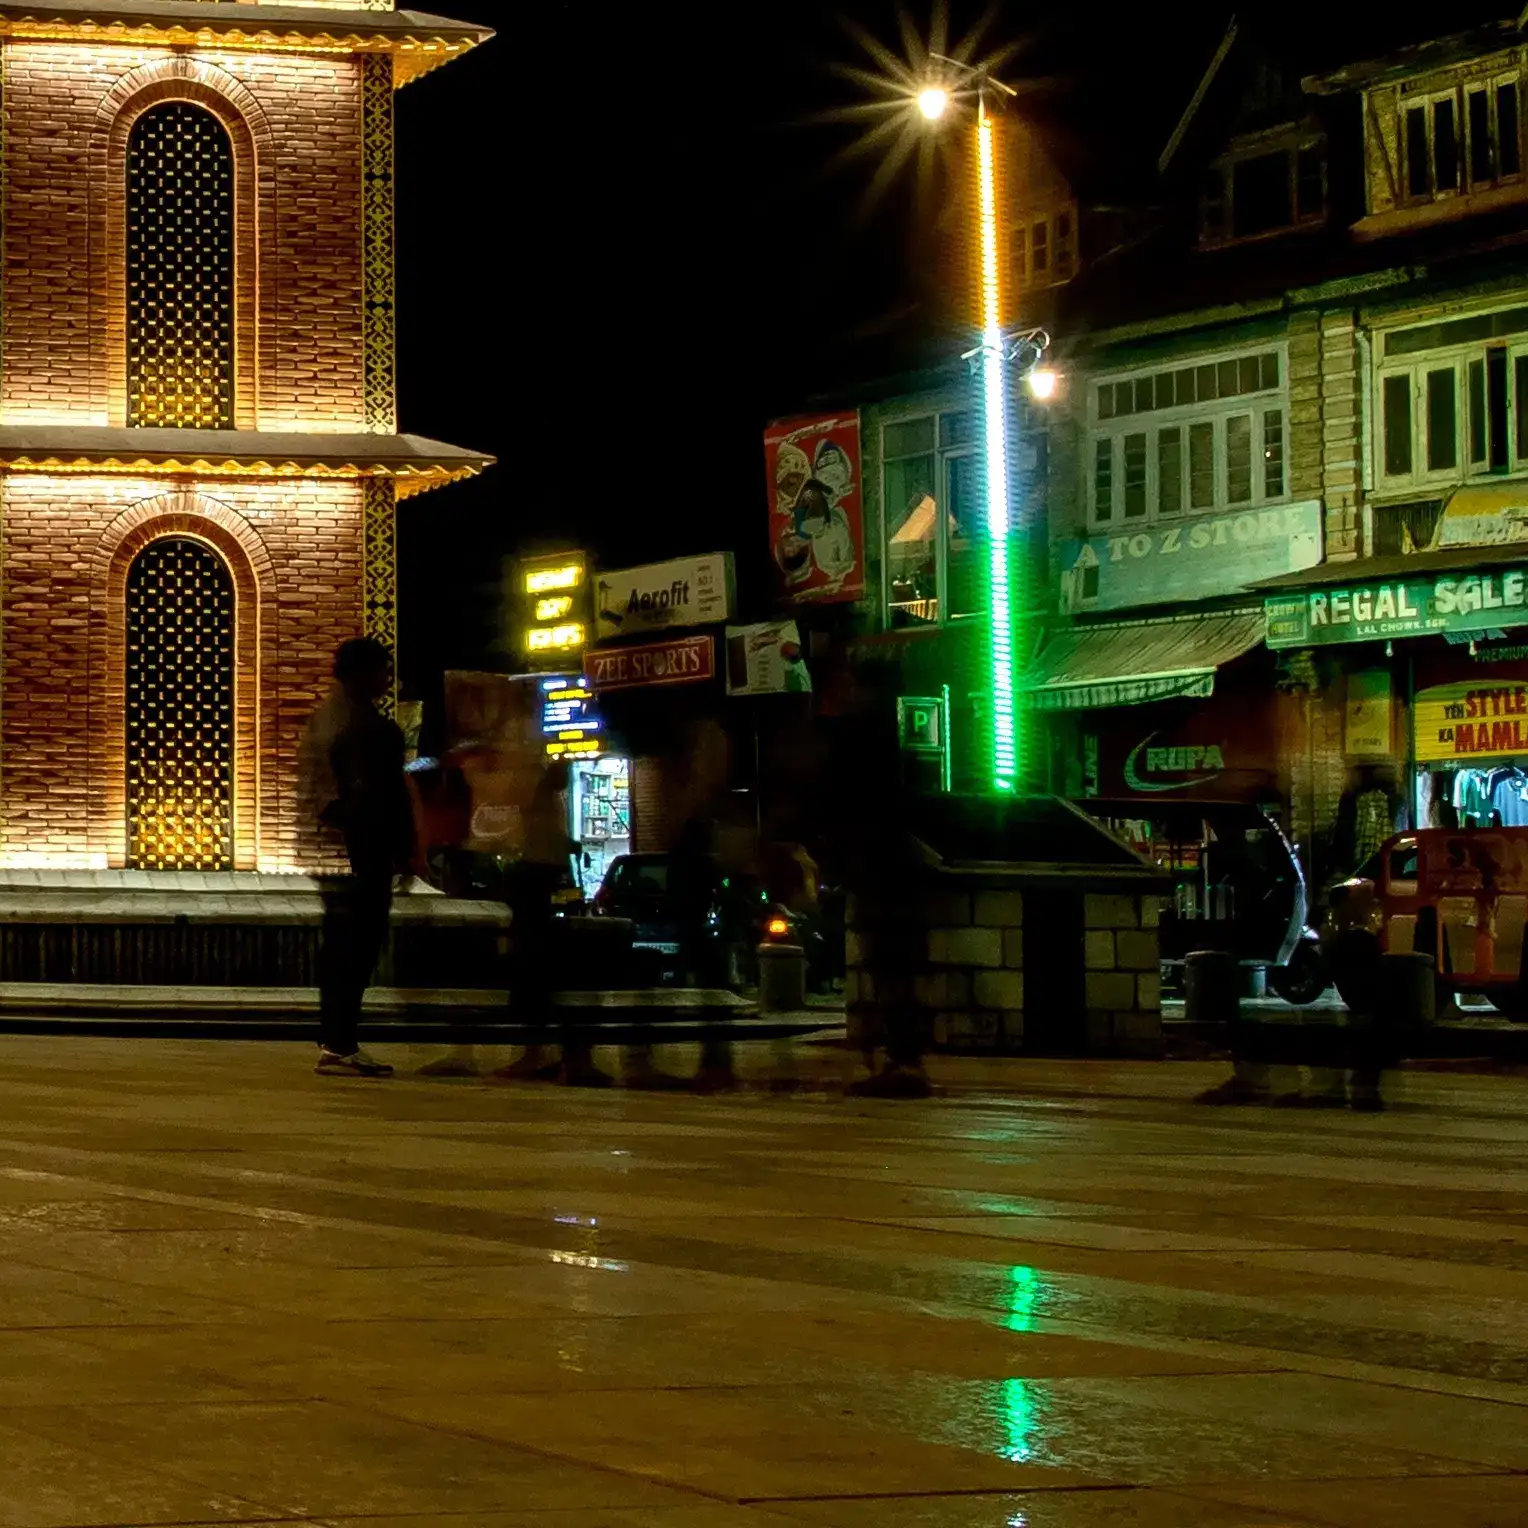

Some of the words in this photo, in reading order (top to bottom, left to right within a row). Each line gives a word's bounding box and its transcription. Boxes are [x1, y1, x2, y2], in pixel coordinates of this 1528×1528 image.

[1109, 534, 1152, 561] TO
[1159, 528, 1182, 554] Z
[1189, 510, 1305, 549] STORE
[627, 580, 689, 613] Aerofit
[1310, 583, 1417, 625] REGAL
[1356, 625, 1378, 635] LAL
[594, 657, 628, 683] ZEE
[632, 646, 700, 680] SPORTS
[1465, 687, 1528, 718] STYLE
[1147, 744, 1225, 772] RUPA
